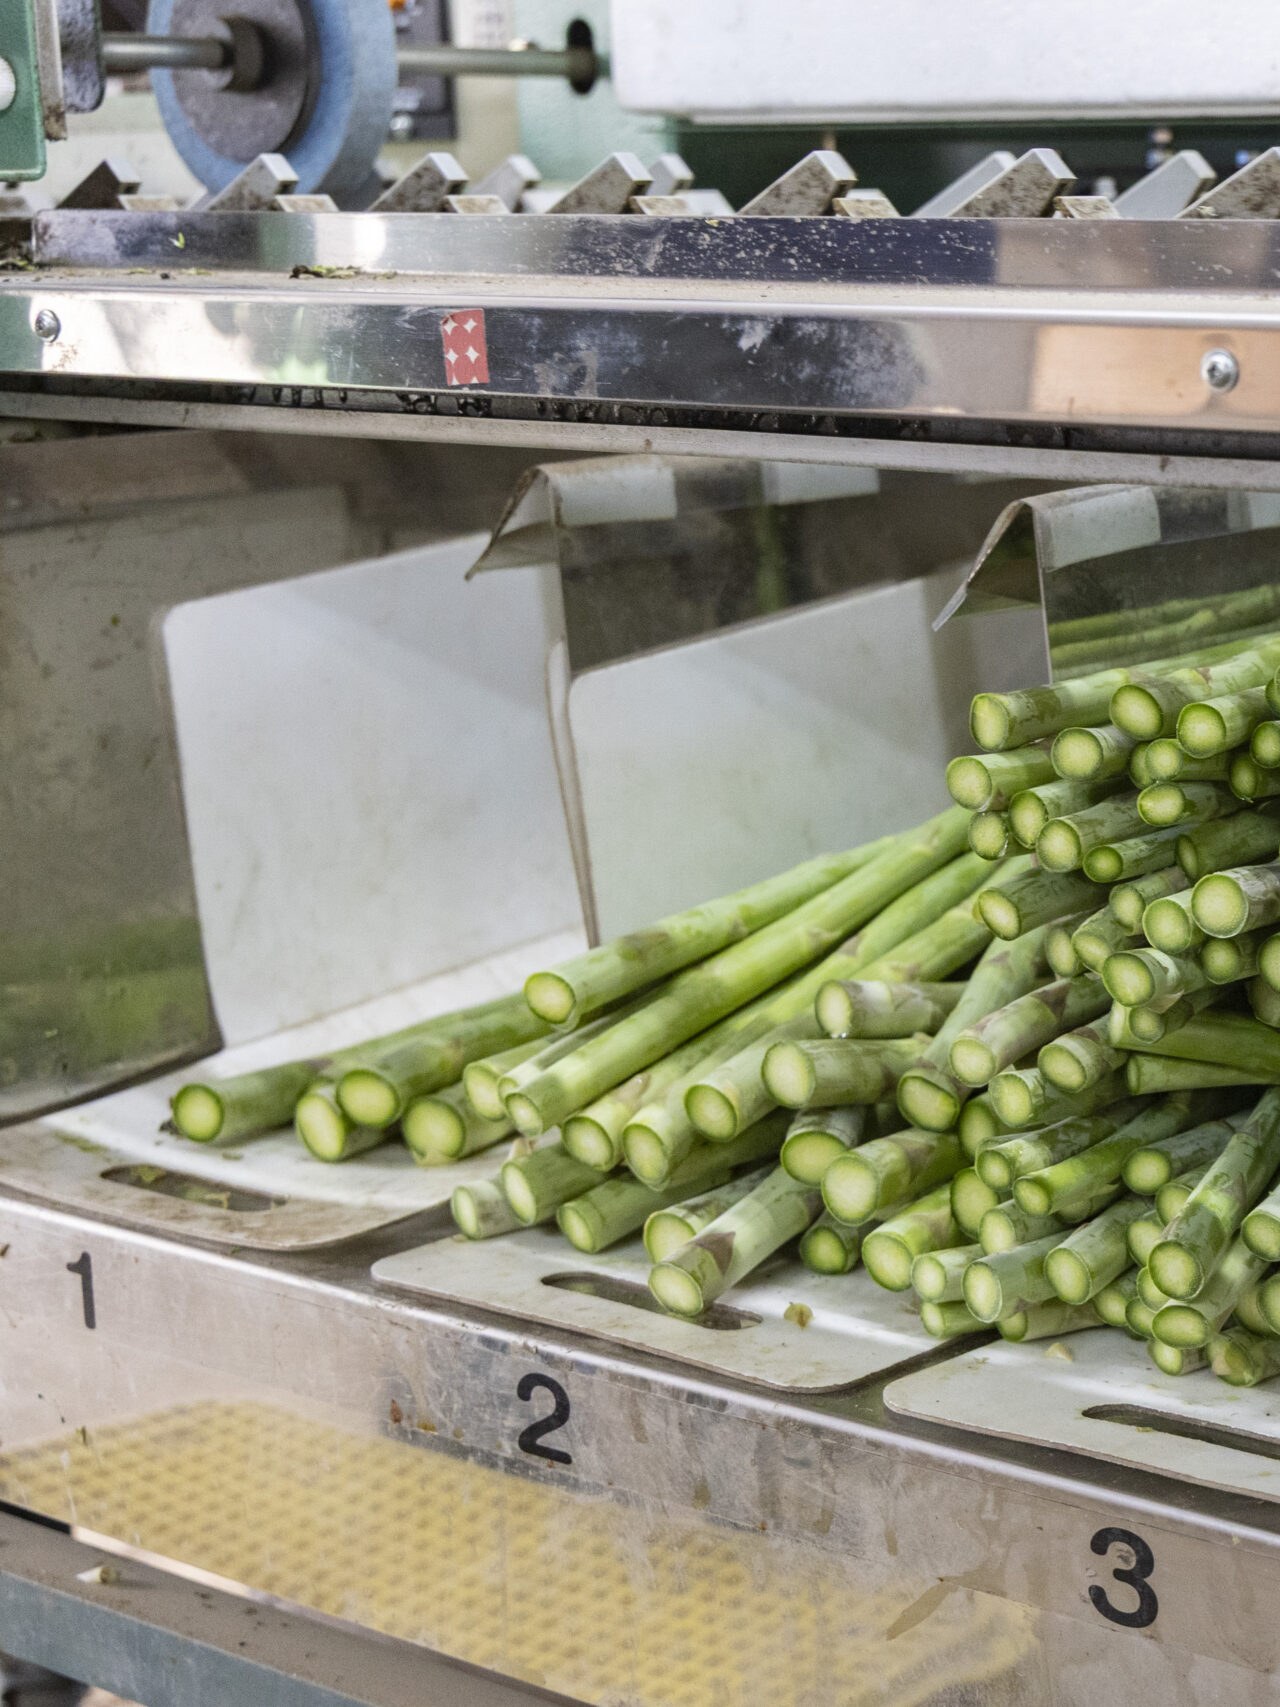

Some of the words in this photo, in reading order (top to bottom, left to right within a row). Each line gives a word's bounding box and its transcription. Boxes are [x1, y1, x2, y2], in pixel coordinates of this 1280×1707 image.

[66, 1251, 96, 1330] 1
[516, 1372, 573, 1466] 2
[1088, 1526, 1160, 1629] 3
